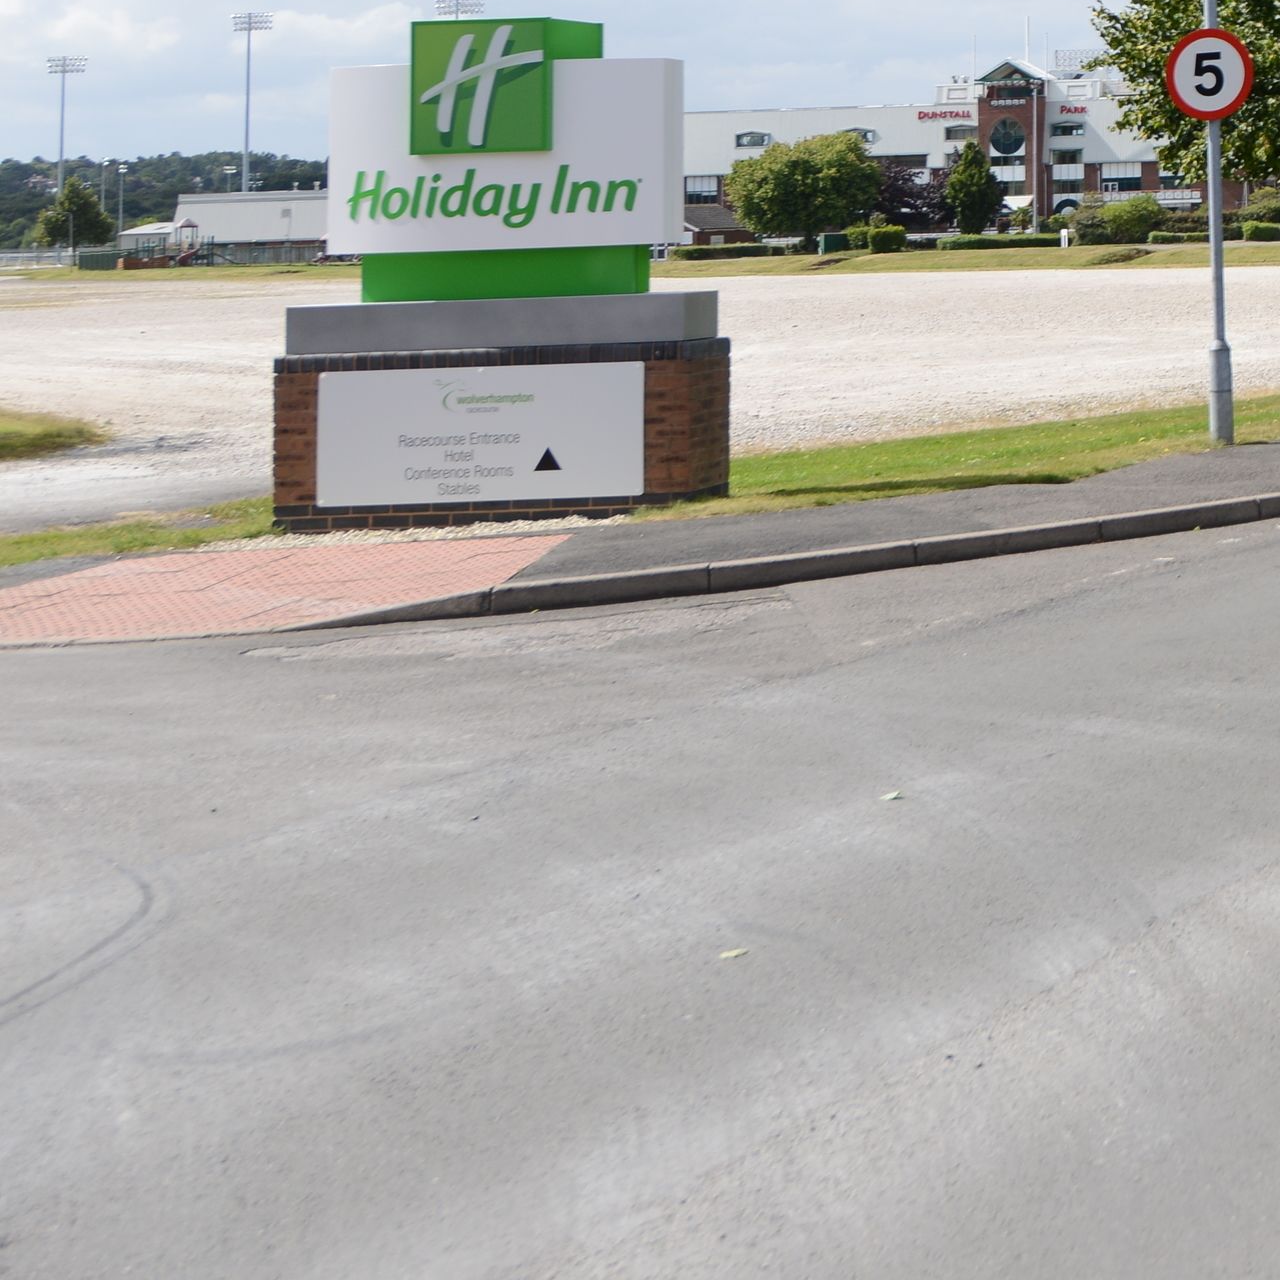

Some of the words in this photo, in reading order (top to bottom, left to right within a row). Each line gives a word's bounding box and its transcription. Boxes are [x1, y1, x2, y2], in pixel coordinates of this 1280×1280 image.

[1194, 51, 1225, 97] 5
[917, 109, 973, 121] DUNSTALL
[347, 168, 543, 229] Holiday
[550, 165, 638, 214] Inn
[456, 392, 535, 405] wolverhampton
[398, 434, 466, 448] Racecourse
[469, 432, 521, 446] Entrance
[444, 449, 474, 463] Hotel
[404, 466, 471, 481] Conference
[474, 464, 514, 478] Rooms
[437, 482, 481, 496] Stables
